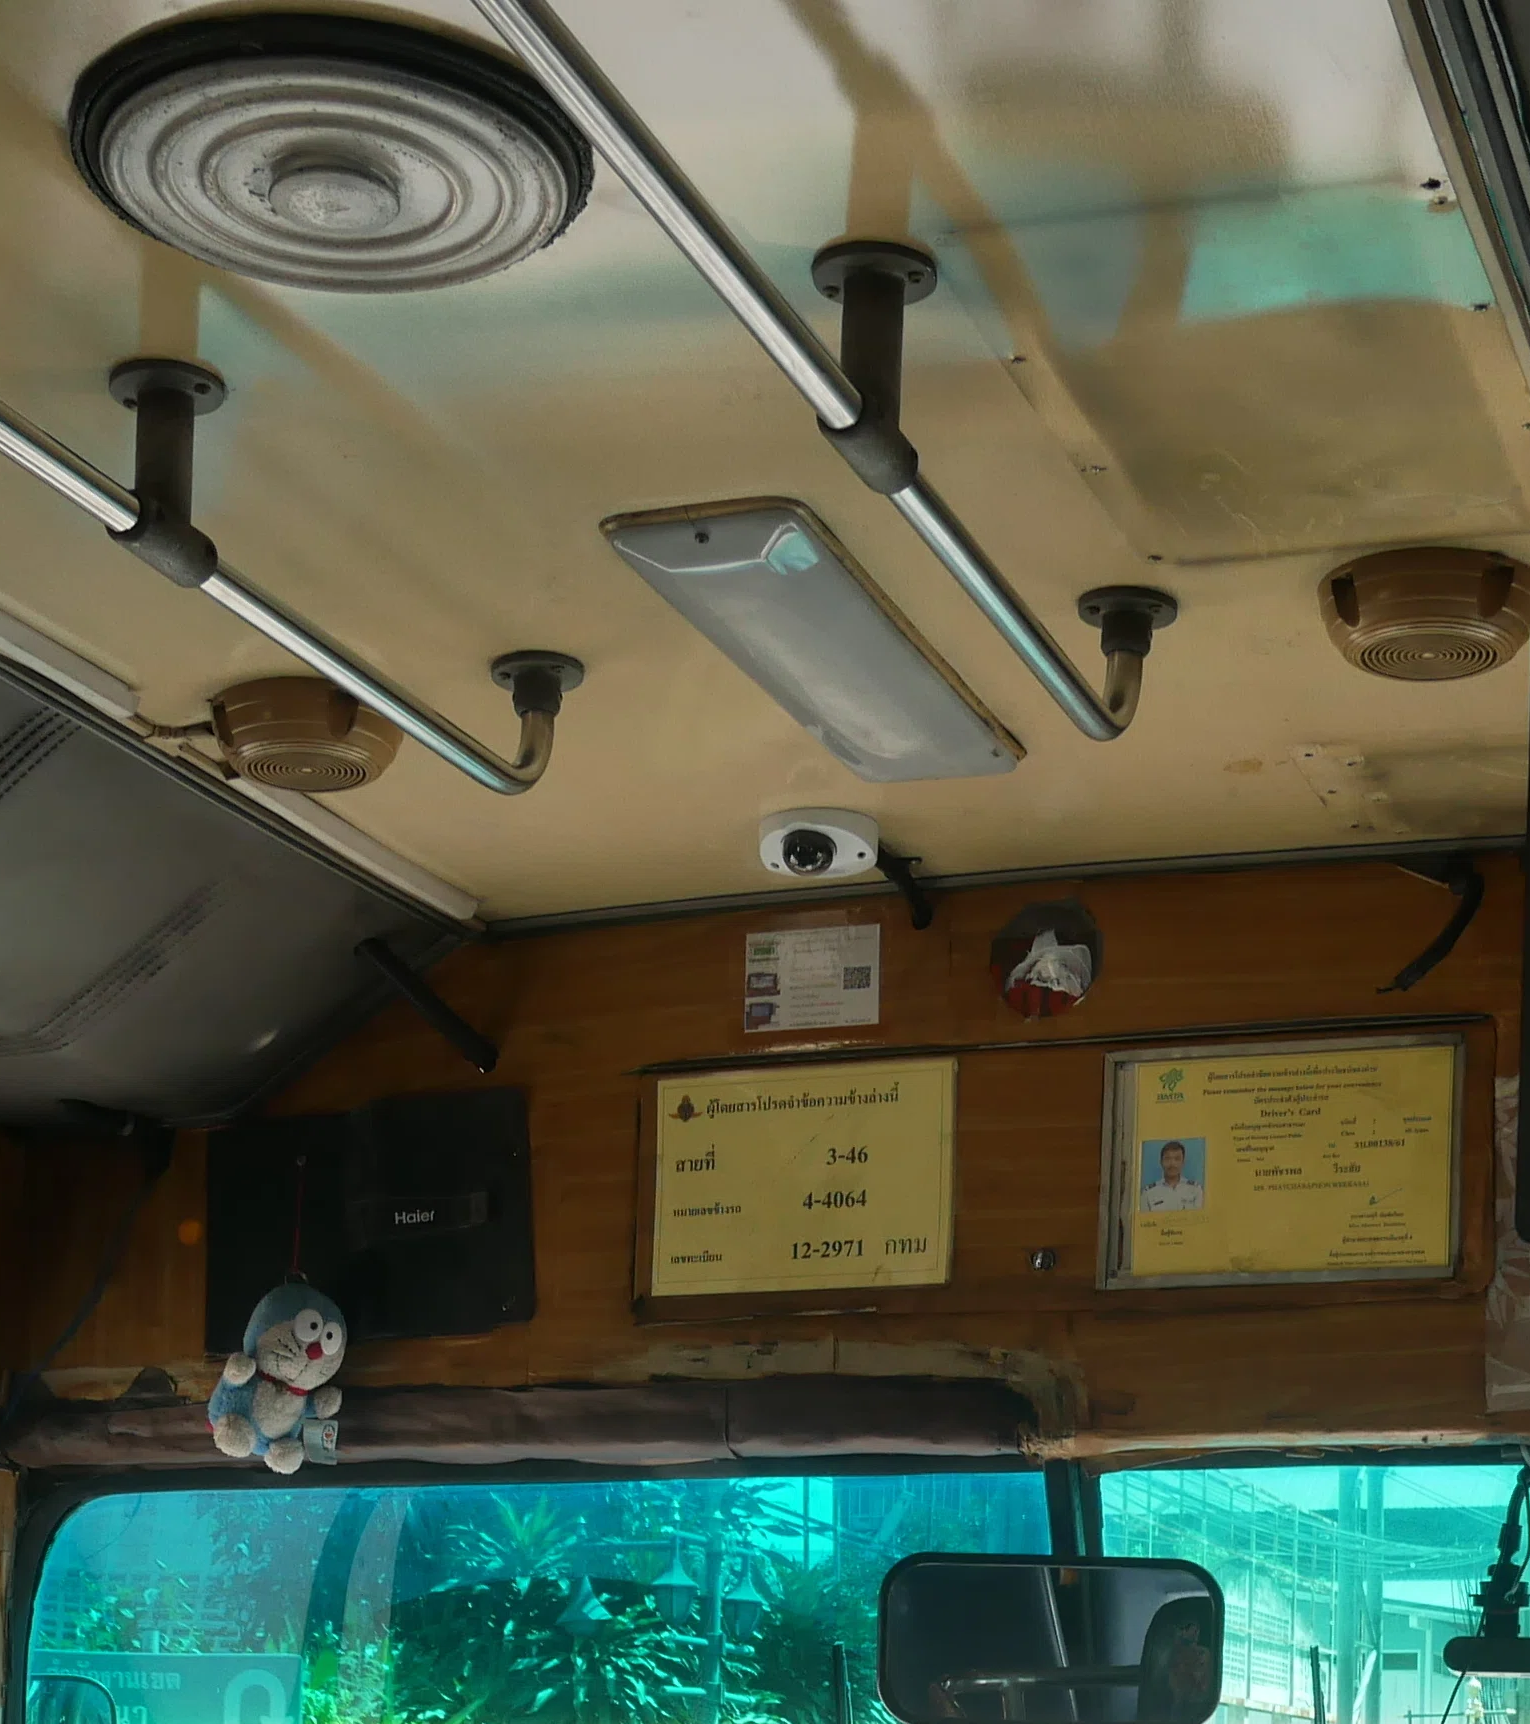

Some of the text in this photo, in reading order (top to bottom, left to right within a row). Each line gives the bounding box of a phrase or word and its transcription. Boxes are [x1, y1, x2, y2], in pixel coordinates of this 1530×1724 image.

[1260, 1107, 1321, 1118] Driver's Card
[675, 1143, 869, 1173] สายที่ 3-46
[802, 1189, 868, 1210] 4-4064
[394, 1208, 436, 1225] Haier
[791, 1239, 865, 1260] 12-2971
[884, 1236, 927, 1256] กทม
